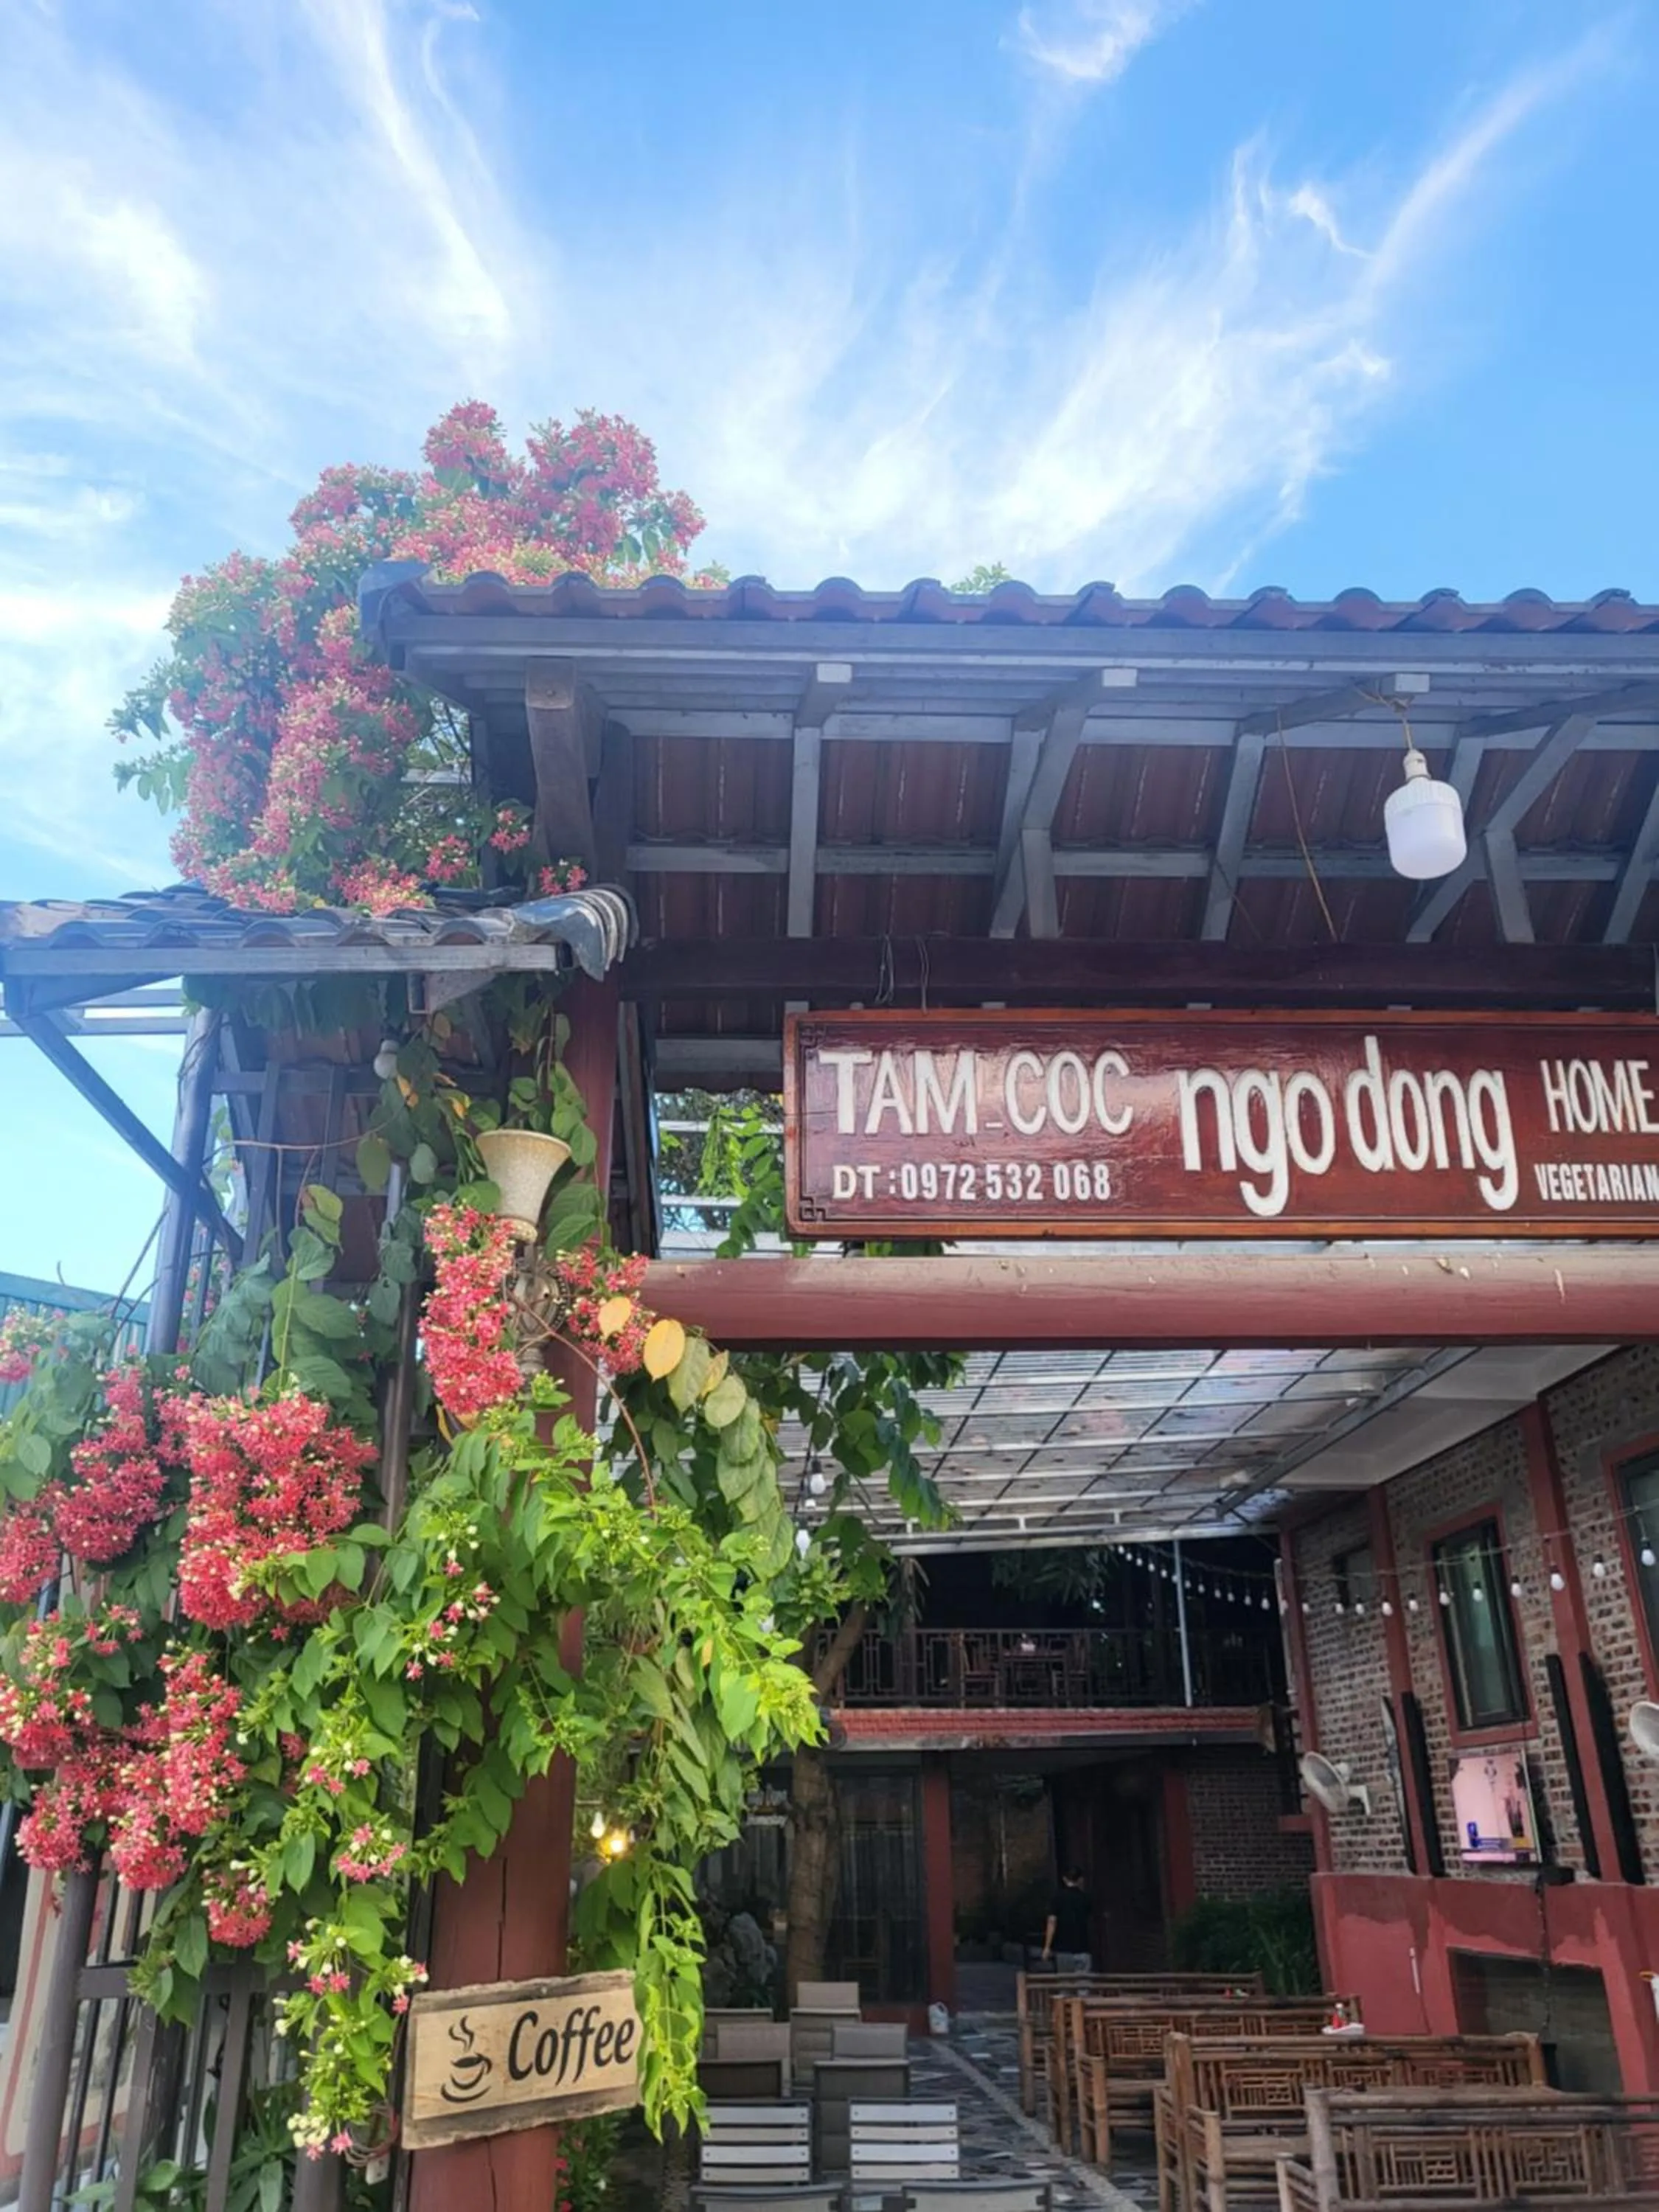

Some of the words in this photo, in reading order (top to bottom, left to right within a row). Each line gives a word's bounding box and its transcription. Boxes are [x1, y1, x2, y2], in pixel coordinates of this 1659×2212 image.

[1178, 1067, 1335, 1217] ngo
[1346, 1035, 1519, 1211] dong
[1540, 1059, 1659, 1133] HOME
[986, 1164, 1043, 1200] 532
[1054, 1164, 1111, 1200] 068
[1534, 1162, 1659, 1201] VEGETARIAN
[508, 2005, 635, 2087] Coffee
